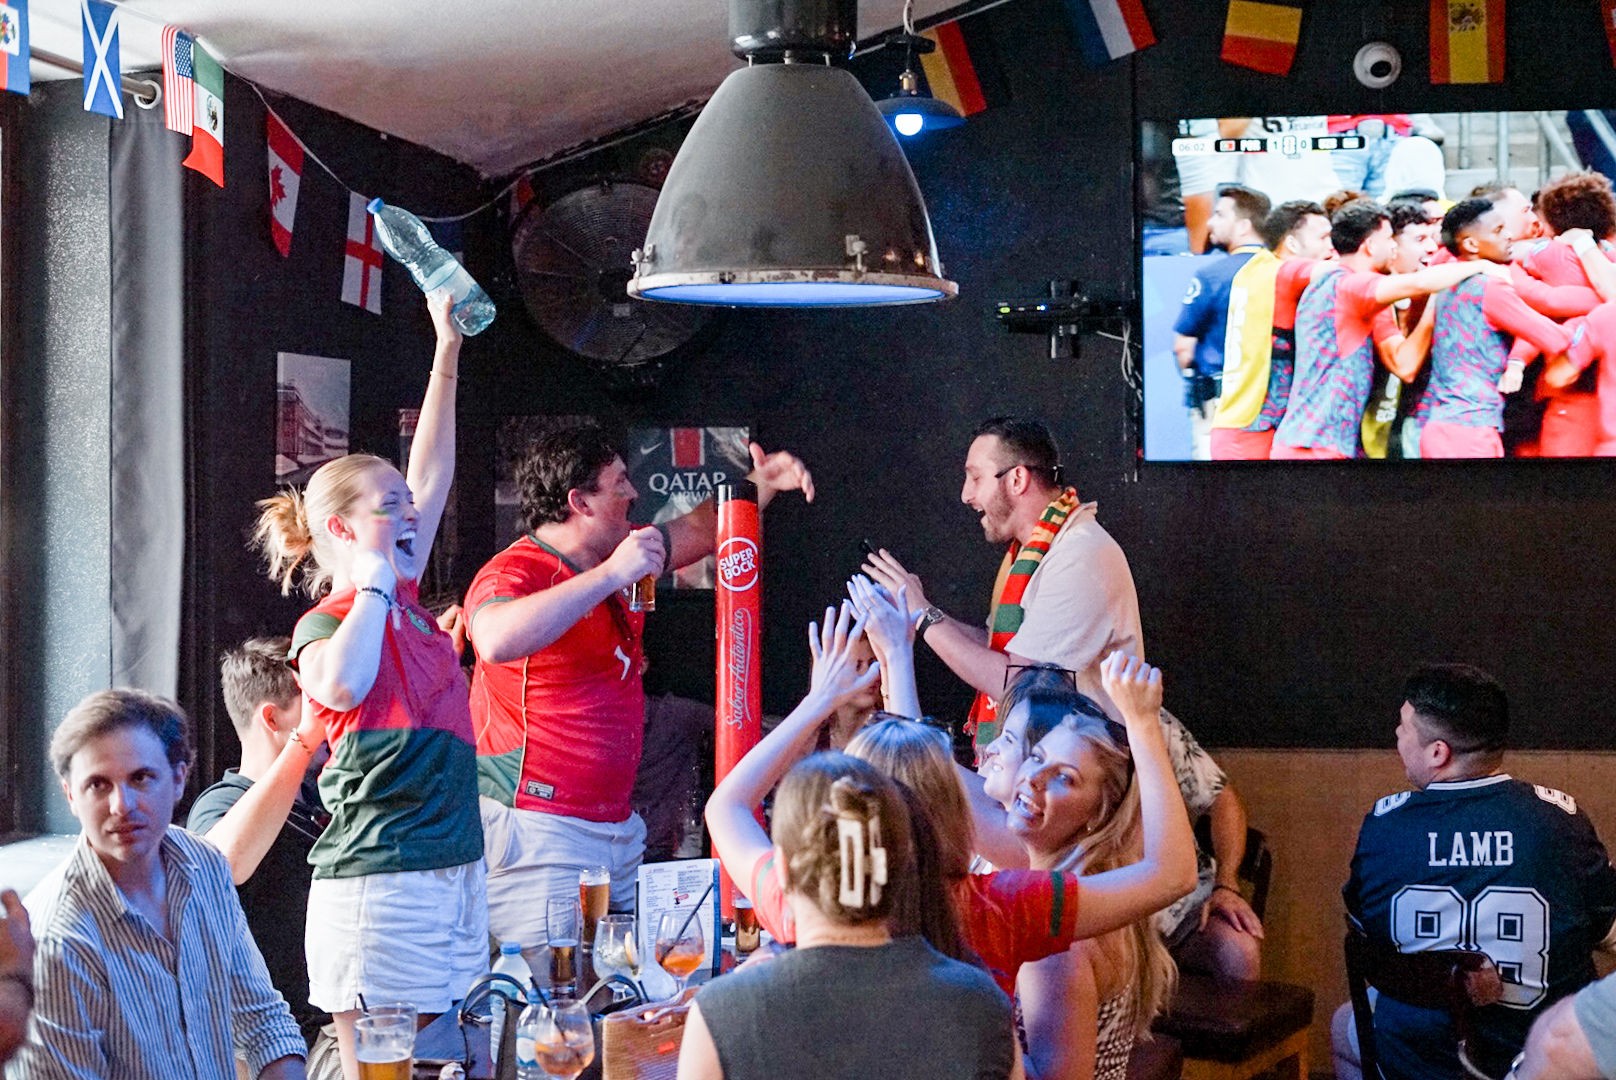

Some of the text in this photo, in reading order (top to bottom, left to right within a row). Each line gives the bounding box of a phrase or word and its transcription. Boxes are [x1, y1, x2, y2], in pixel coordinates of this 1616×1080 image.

[1301, 140, 1307, 149] 0
[719, 547, 755, 570] SUPER
[723, 558, 756, 581] BOCK
[724, 682, 746, 730] Sabor
[1427, 830, 1515, 867] LAMB
